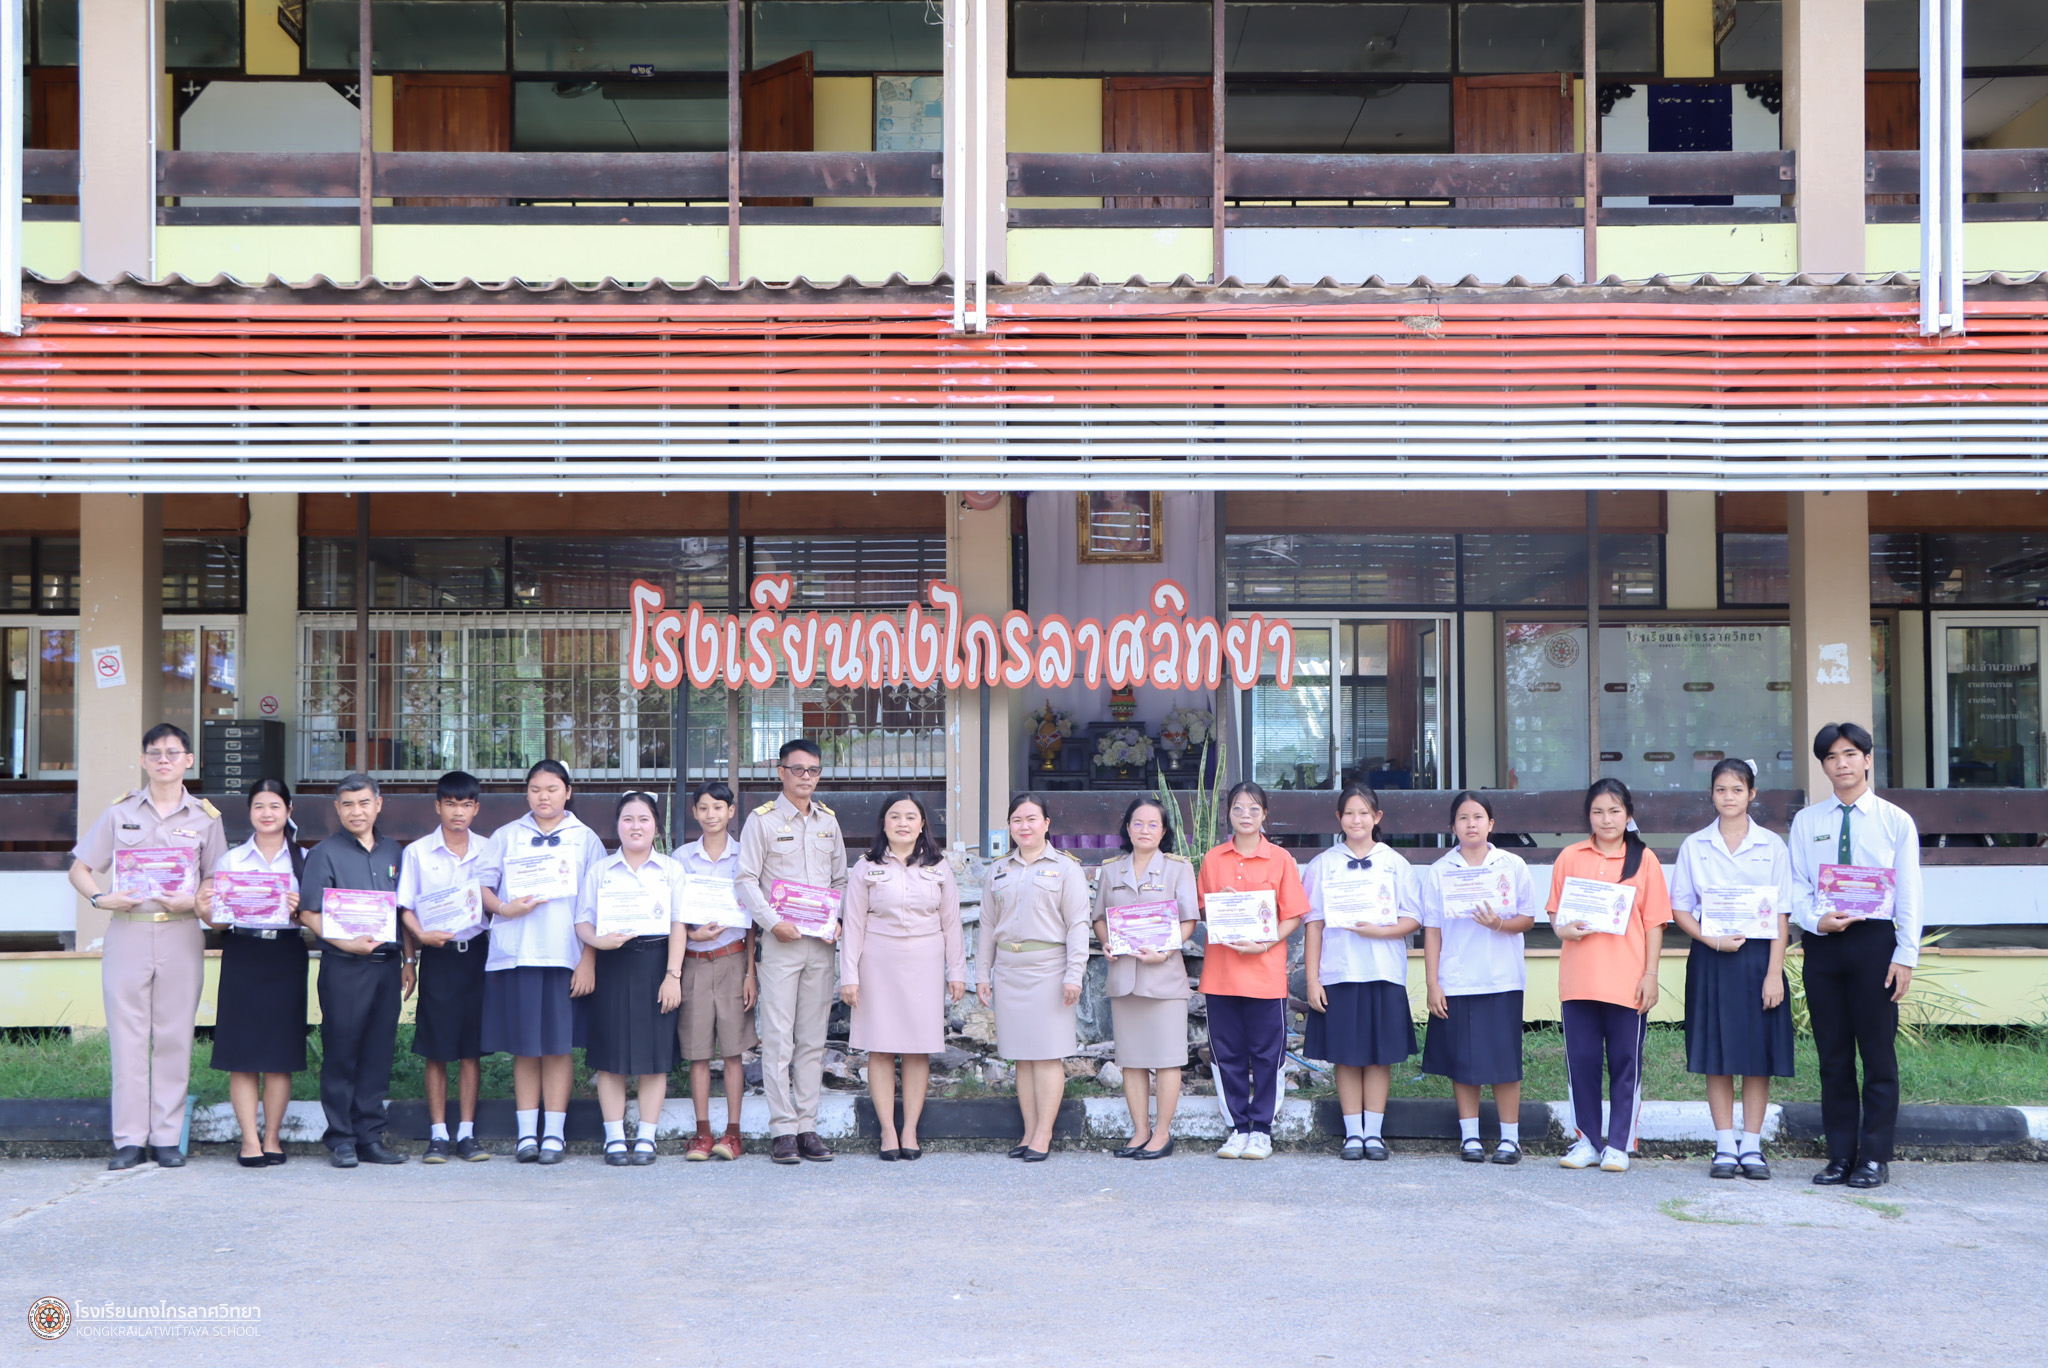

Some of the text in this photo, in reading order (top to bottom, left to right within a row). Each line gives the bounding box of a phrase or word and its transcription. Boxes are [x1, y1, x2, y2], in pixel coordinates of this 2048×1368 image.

[630, 573, 1295, 690] โรงเรียนกงไกรลาศวิทยา
